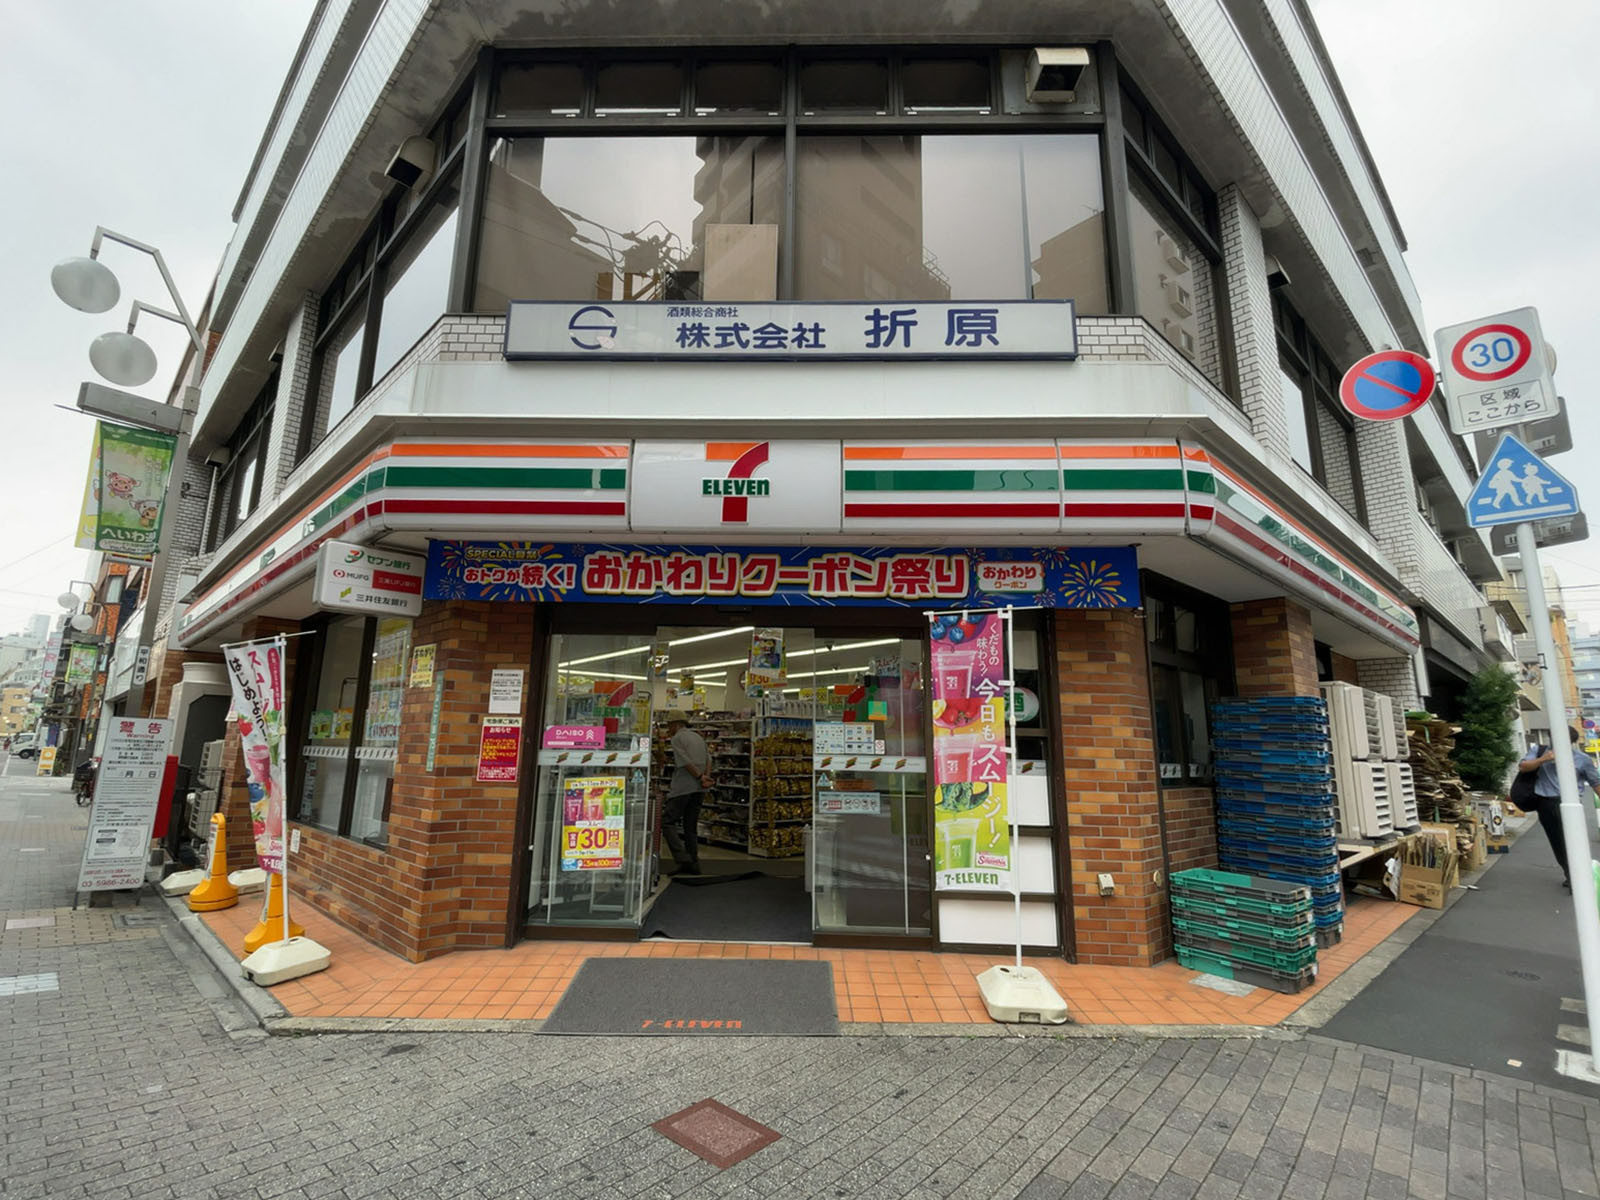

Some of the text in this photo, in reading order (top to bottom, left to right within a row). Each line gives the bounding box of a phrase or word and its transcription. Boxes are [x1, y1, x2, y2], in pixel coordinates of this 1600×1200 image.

[666, 305, 739, 319] 酒類総合商社
[675, 307, 1000, 349] 株式会社 折原
[1469, 337, 1515, 367] 30
[1480, 387, 1521, 406] 区域
[1467, 400, 1541, 424] ここから
[367, 555, 412, 570] セブン銀行
[983, 565, 1037, 580] おかわり
[347, 571, 370, 581] MUFG
[463, 564, 574, 588] おトクが続く!
[585, 552, 967, 597] おかわりクーポン祭り
[994, 581, 1028, 589] クーポン
[355, 594, 409, 608] 三井住友銀行
[988, 622, 1000, 666] くだもの
[136, 648, 149, 683] 平和通り
[120, 721, 162, 735] 警告
[974, 677, 1002, 848] 今日もスムージー!
